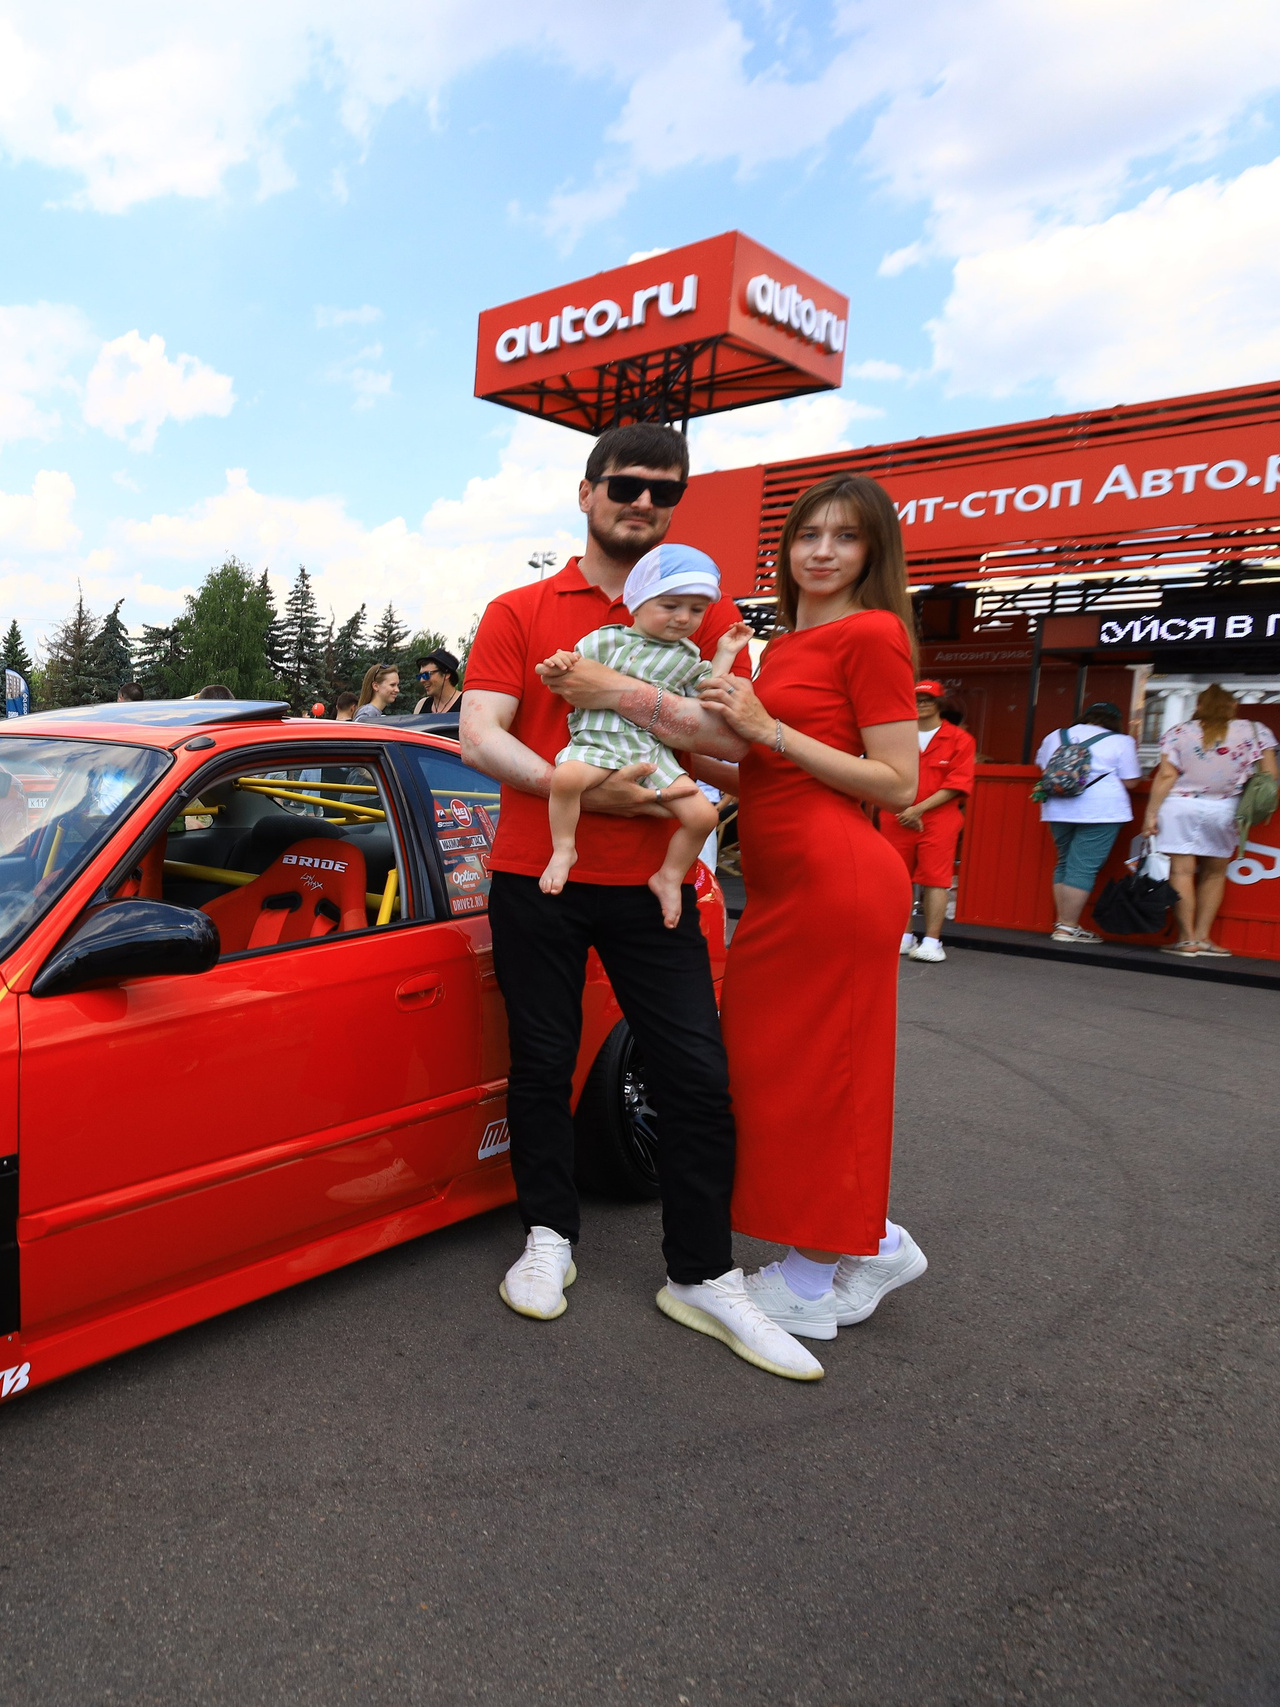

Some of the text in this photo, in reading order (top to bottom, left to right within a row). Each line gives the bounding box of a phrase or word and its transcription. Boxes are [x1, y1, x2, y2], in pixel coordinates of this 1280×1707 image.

[495, 274, 698, 363] auto.ru
[747, 274, 846, 353] auto.ru
[893, 478, 1083, 526] ит-стоп
[282, 854, 349, 873] BRIDE
[452, 869, 480, 886] Option
[452, 895, 484, 911] DRIVE2.RU
